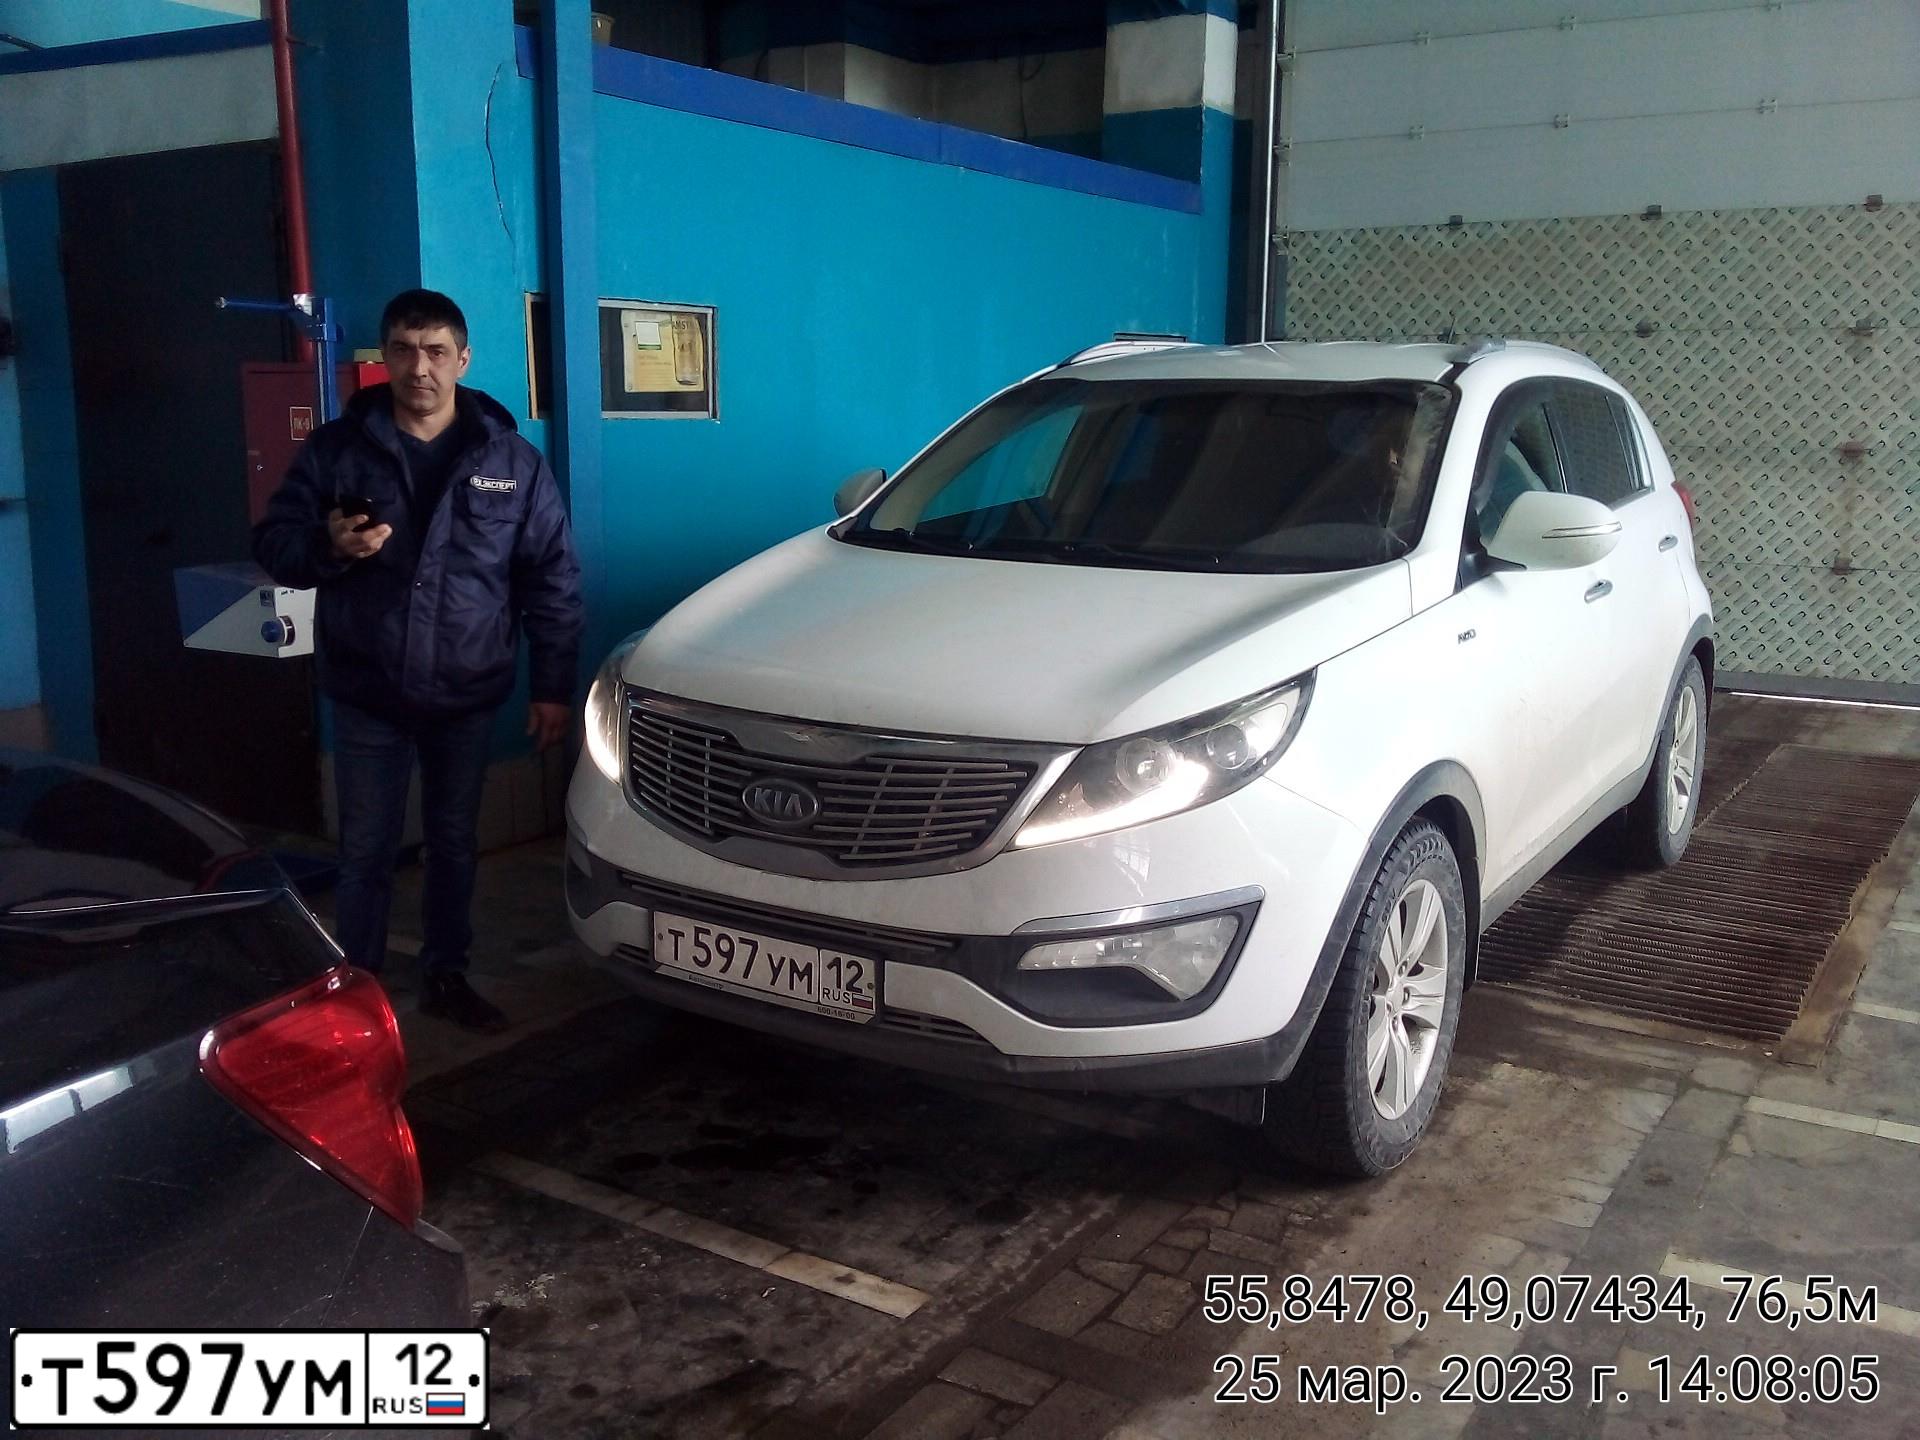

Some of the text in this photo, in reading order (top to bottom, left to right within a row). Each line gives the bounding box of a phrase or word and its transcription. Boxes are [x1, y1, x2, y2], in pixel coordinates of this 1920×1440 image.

[753, 786, 803, 817] KIA
[826, 956, 864, 994] 12
[822, 987, 852, 1004] RUS
